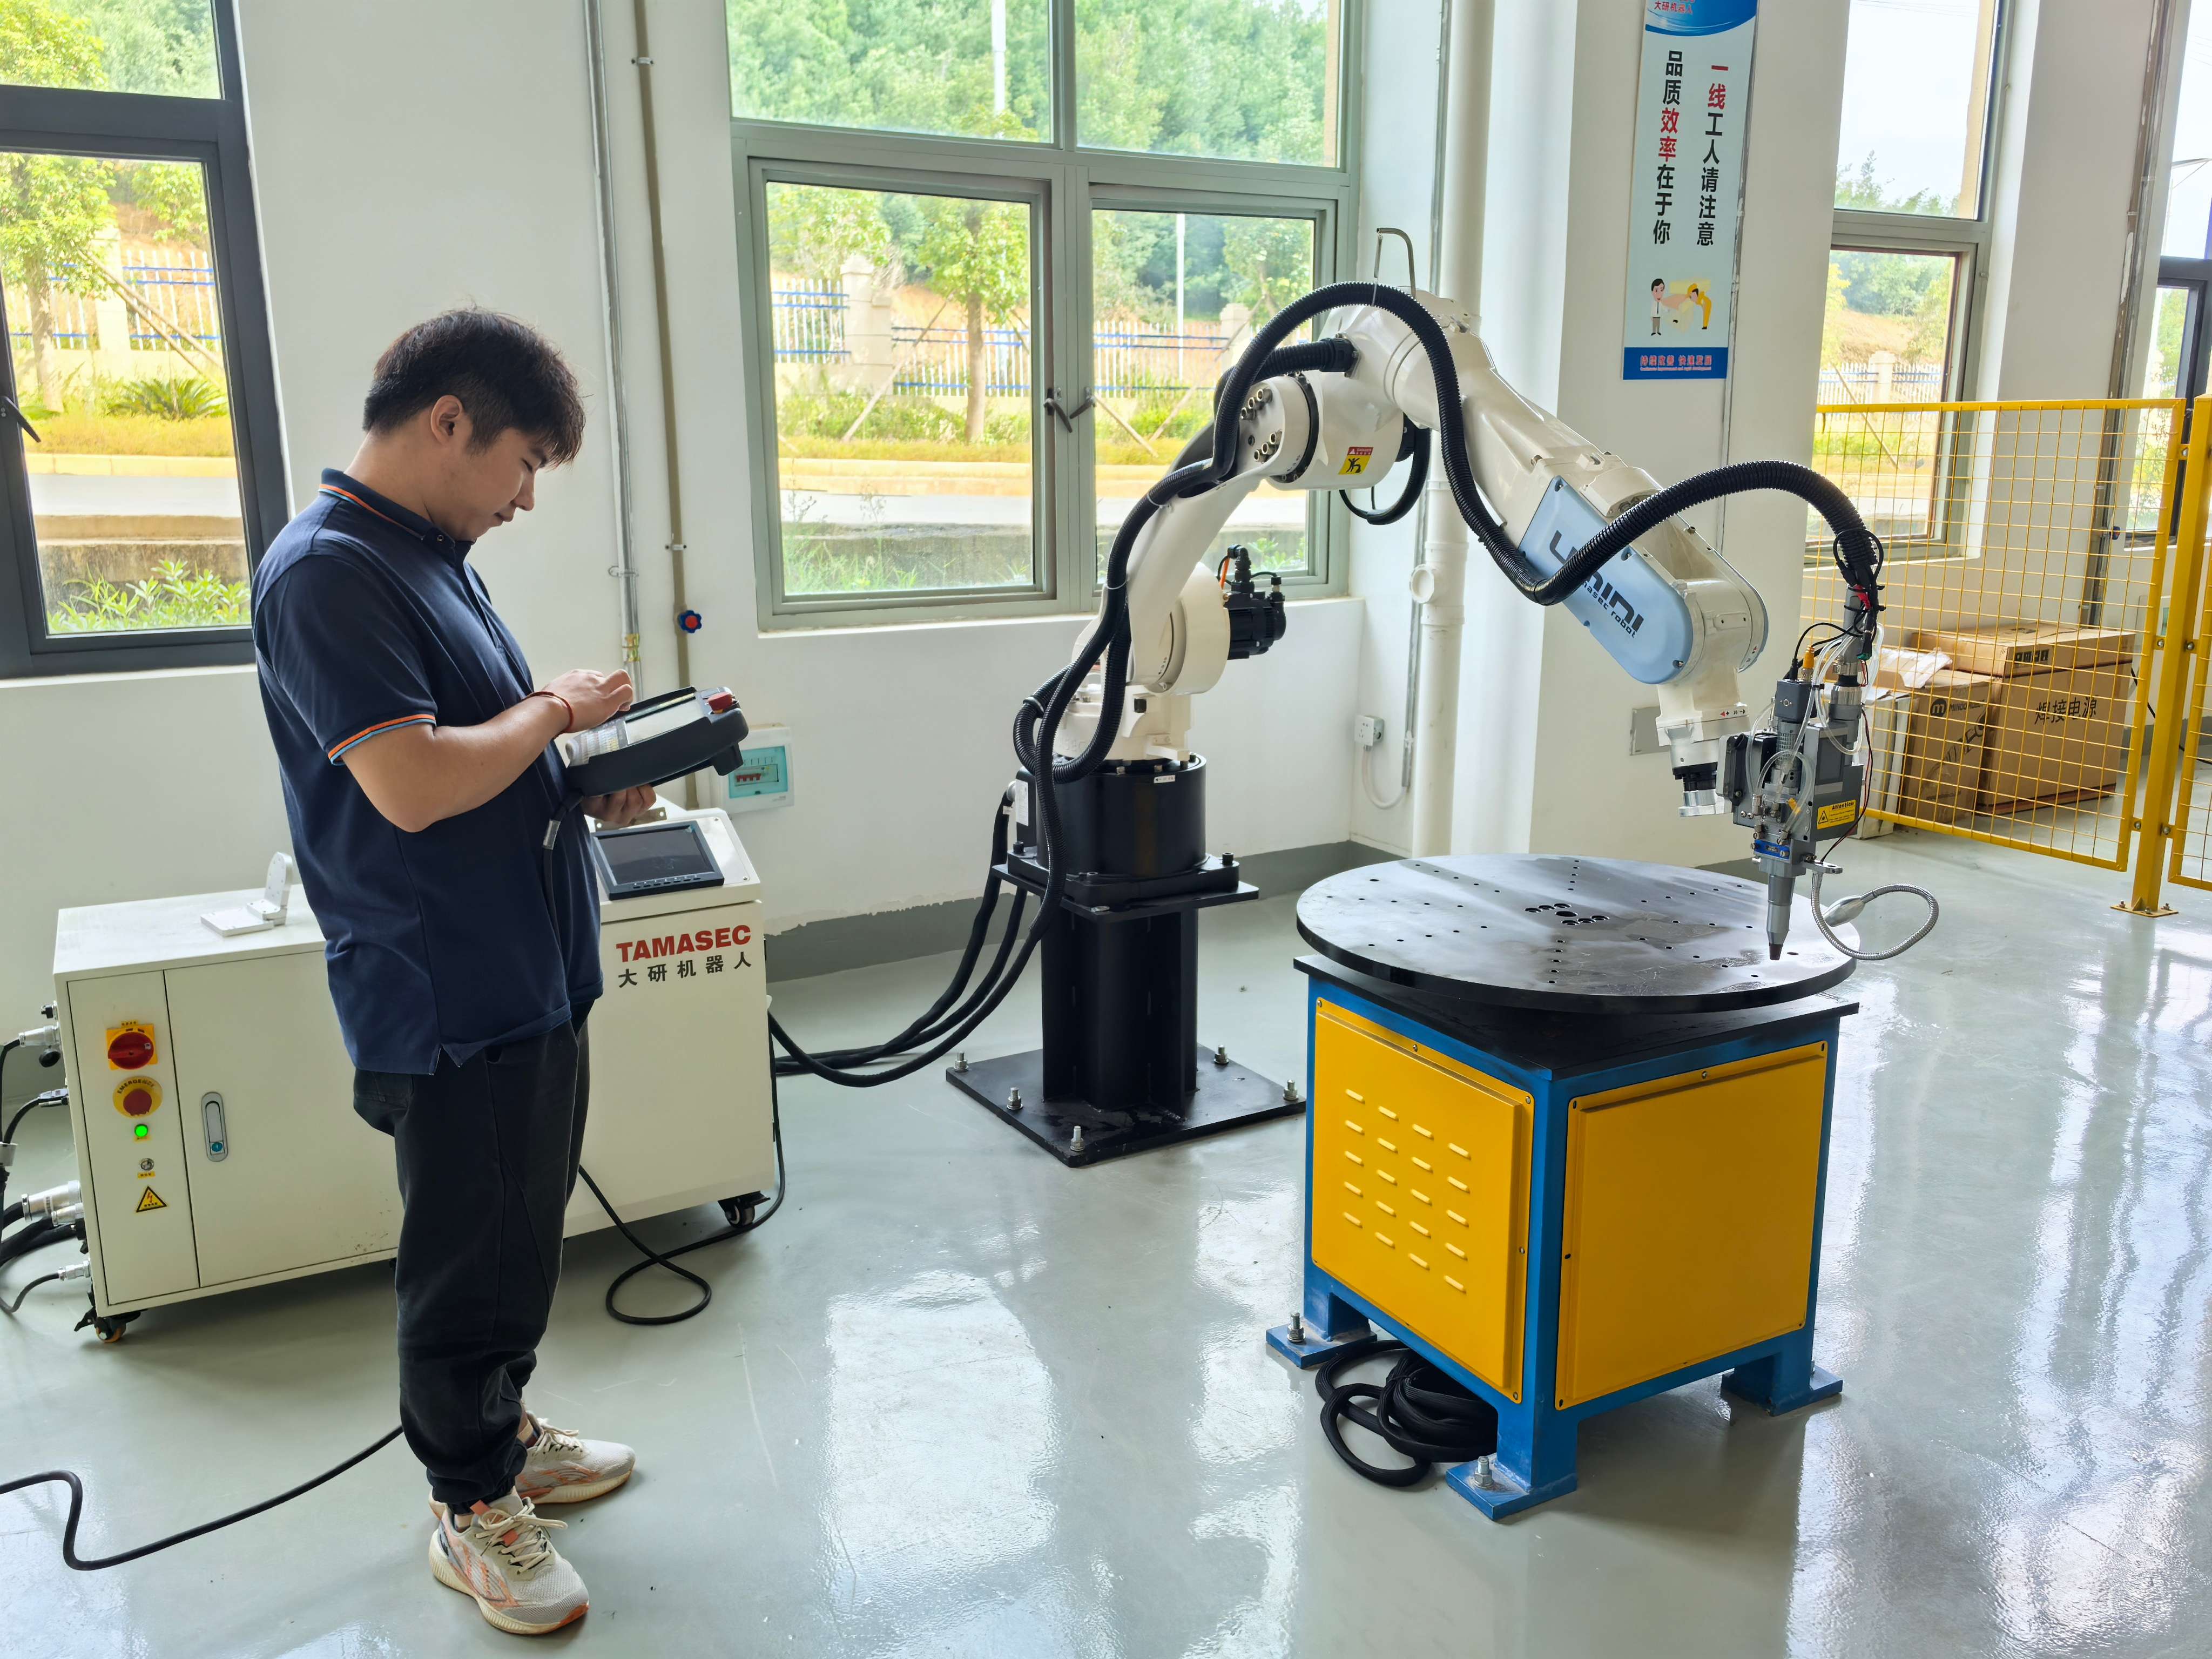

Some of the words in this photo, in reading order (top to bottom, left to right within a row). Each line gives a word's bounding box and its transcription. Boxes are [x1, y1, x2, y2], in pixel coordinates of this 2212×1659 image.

[1653, 50, 1683, 245] 品质效率在于你
[1697, 64, 1729, 246] 一线工人请注意
[1611, 610, 1636, 638] robot
[2034, 696, 2097, 725] 焊接电源
[616, 925, 751, 962] TAMASEC
[618, 952, 751, 988] 大研机器人
